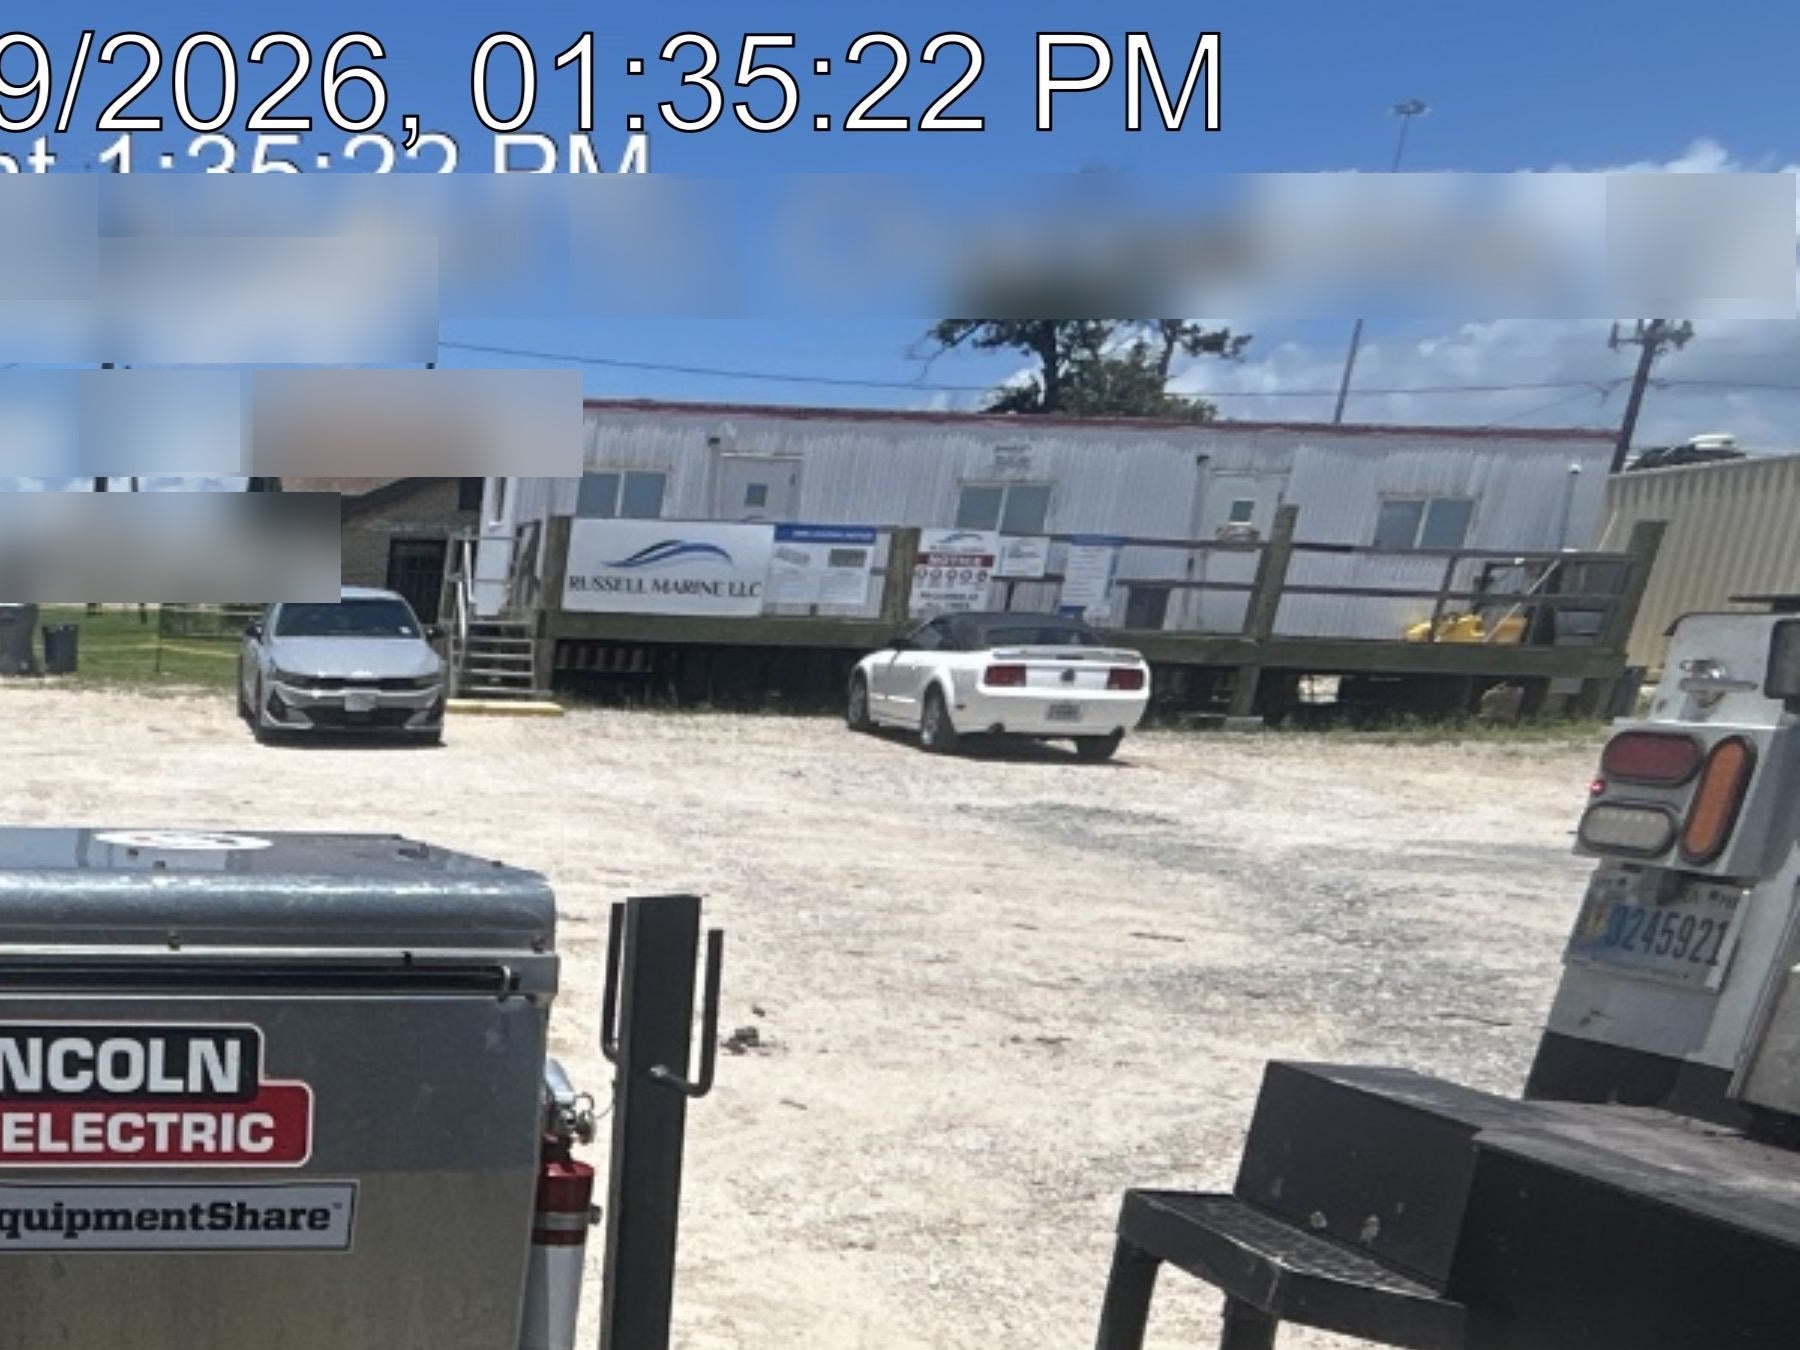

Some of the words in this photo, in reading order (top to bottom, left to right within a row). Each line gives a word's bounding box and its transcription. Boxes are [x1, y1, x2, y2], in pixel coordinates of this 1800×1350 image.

[568, 575, 647, 595] RUSSELL
[650, 577, 726, 597] MARINE
[728, 580, 762, 598] LLC
[1, 1112, 275, 1153] ELECTRIC
